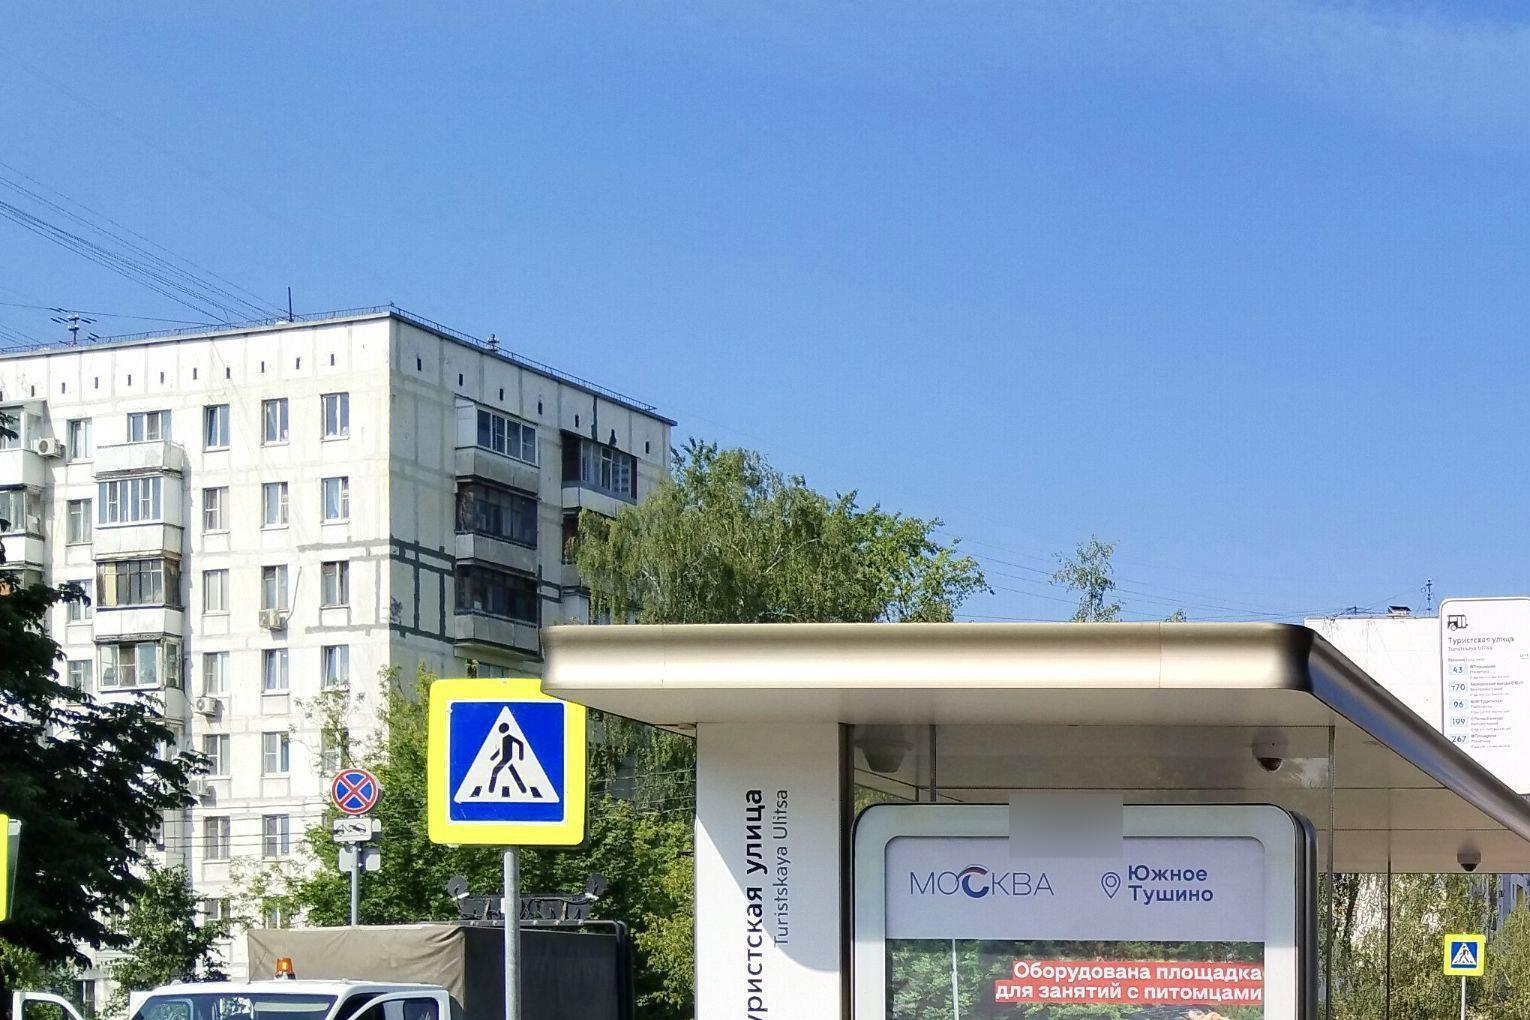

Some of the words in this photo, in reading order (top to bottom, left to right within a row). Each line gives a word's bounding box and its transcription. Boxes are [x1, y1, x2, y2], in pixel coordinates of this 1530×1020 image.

[1453, 666, 1463, 674] 43
[1452, 718, 1466, 726] 199
[1452, 735, 1466, 743] 267
[772, 789, 788, 840] Ulitsa
[745, 789, 768, 875] улица
[909, 863, 1055, 899] МОСКВА
[1128, 864, 1208, 882] Южное
[772, 846, 791, 948] Turistskaya
[1127, 884, 1214, 906] Тушино
[1013, 961, 1152, 983] Оборудована
[1156, 965, 1263, 983] площадка
[995, 984, 1034, 1000] для
[1038, 982, 1122, 999] занятий
[1127, 985, 1140, 999] с
[1144, 985, 1263, 1002] питомцами
